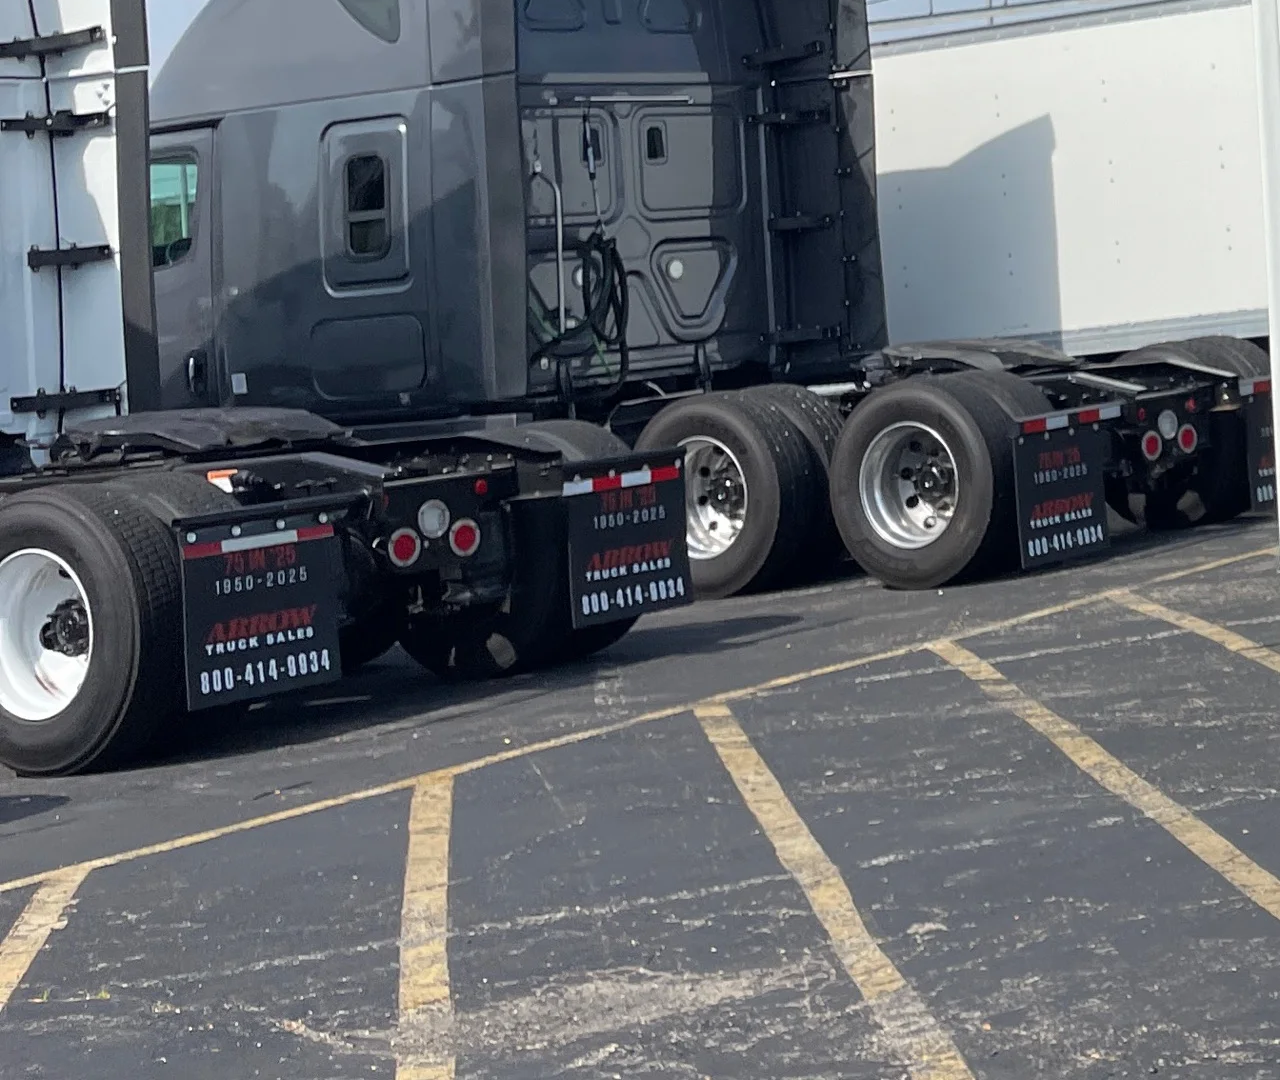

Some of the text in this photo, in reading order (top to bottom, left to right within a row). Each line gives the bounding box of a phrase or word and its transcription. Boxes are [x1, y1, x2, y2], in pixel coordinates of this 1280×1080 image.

[1029, 515, 1061, 530] TRUCK
[215, 565, 308, 596] 1950-2025
[585, 557, 671, 583] TRUCK SALES
[581, 576, 685, 616] 800-414-0034
[205, 626, 314, 656] TRUCK SALES
[200, 648, 331, 695] 800-414-0034
